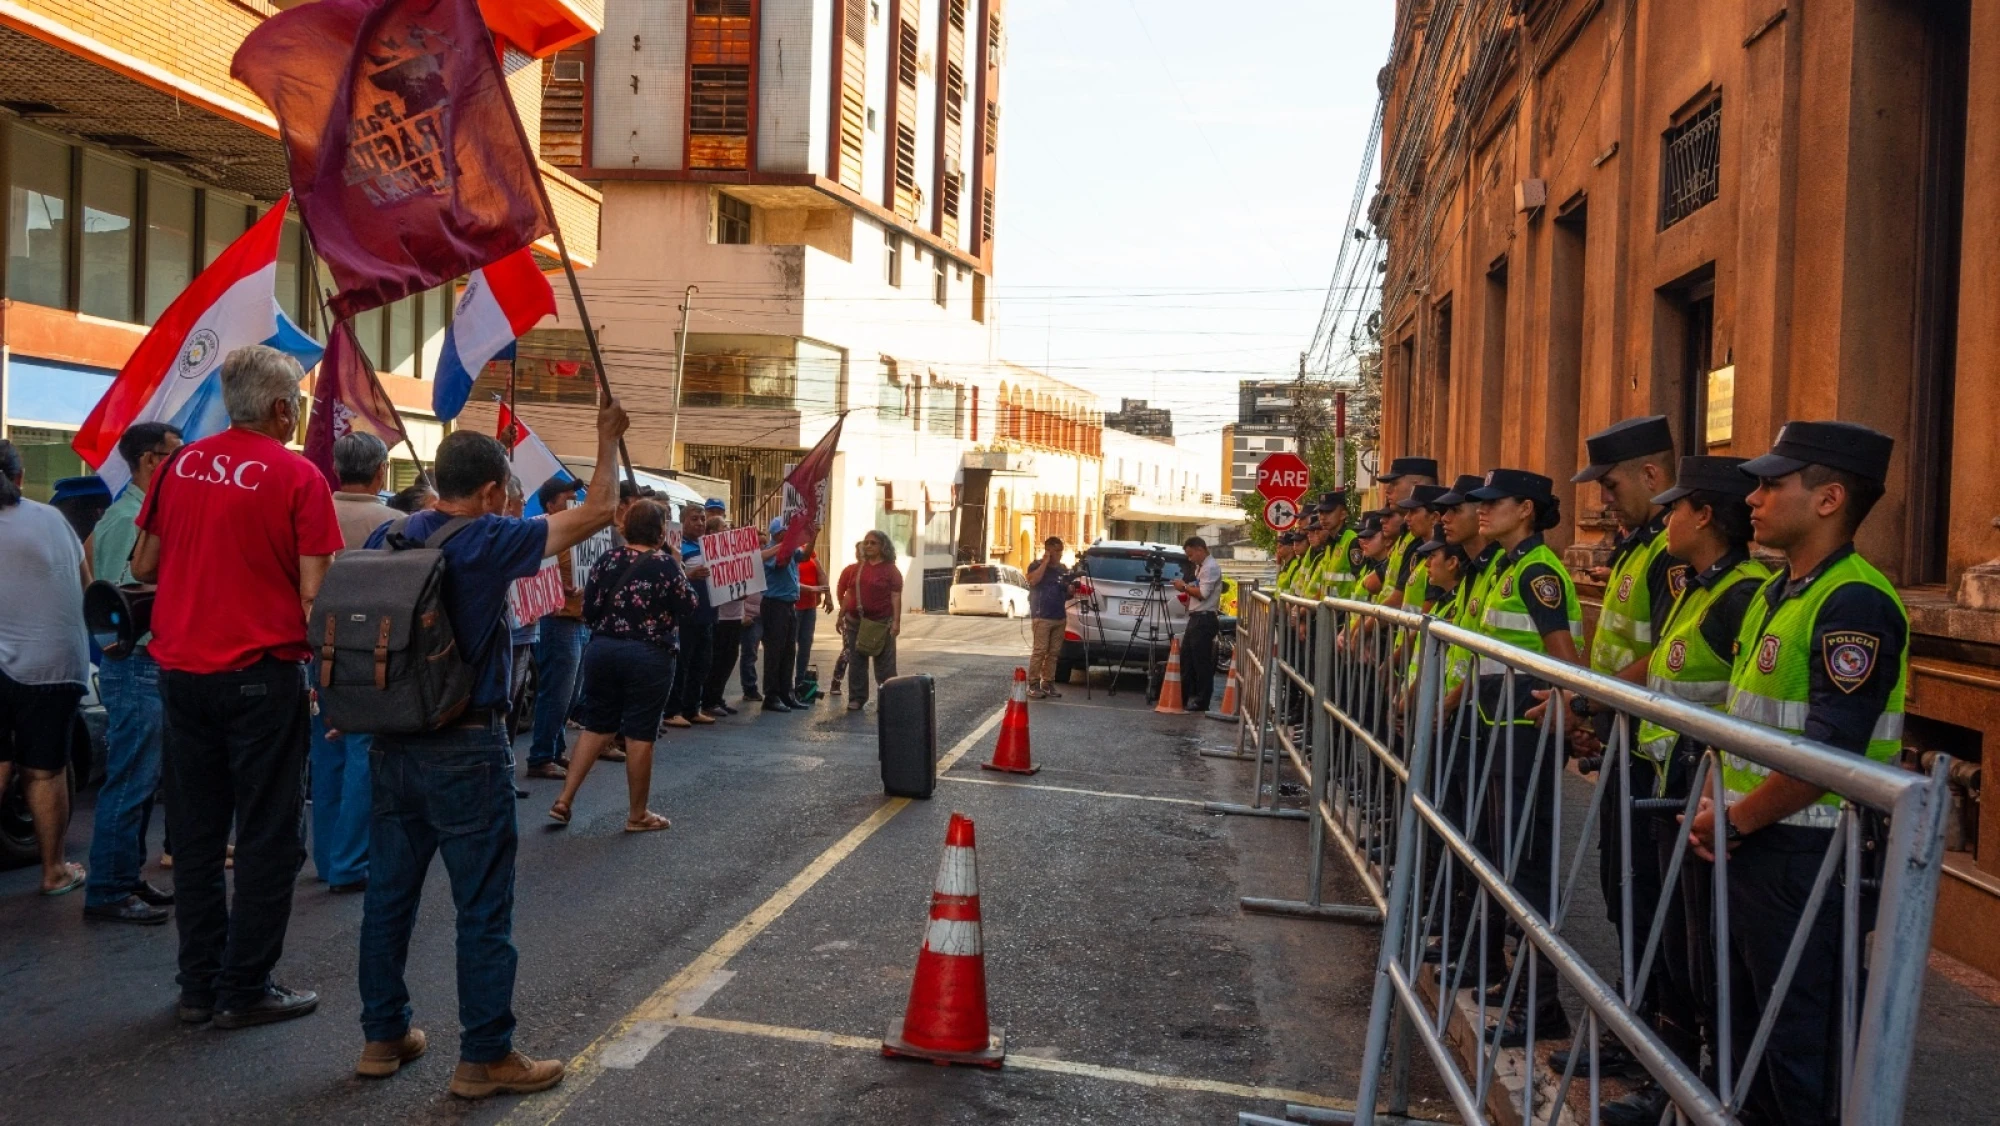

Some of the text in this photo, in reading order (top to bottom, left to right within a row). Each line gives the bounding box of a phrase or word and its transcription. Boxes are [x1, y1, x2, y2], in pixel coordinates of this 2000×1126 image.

[175, 449, 269, 491] C.S.C
[1257, 469, 1307, 487] PARE
[1828, 635, 1874, 649] POLICIA
